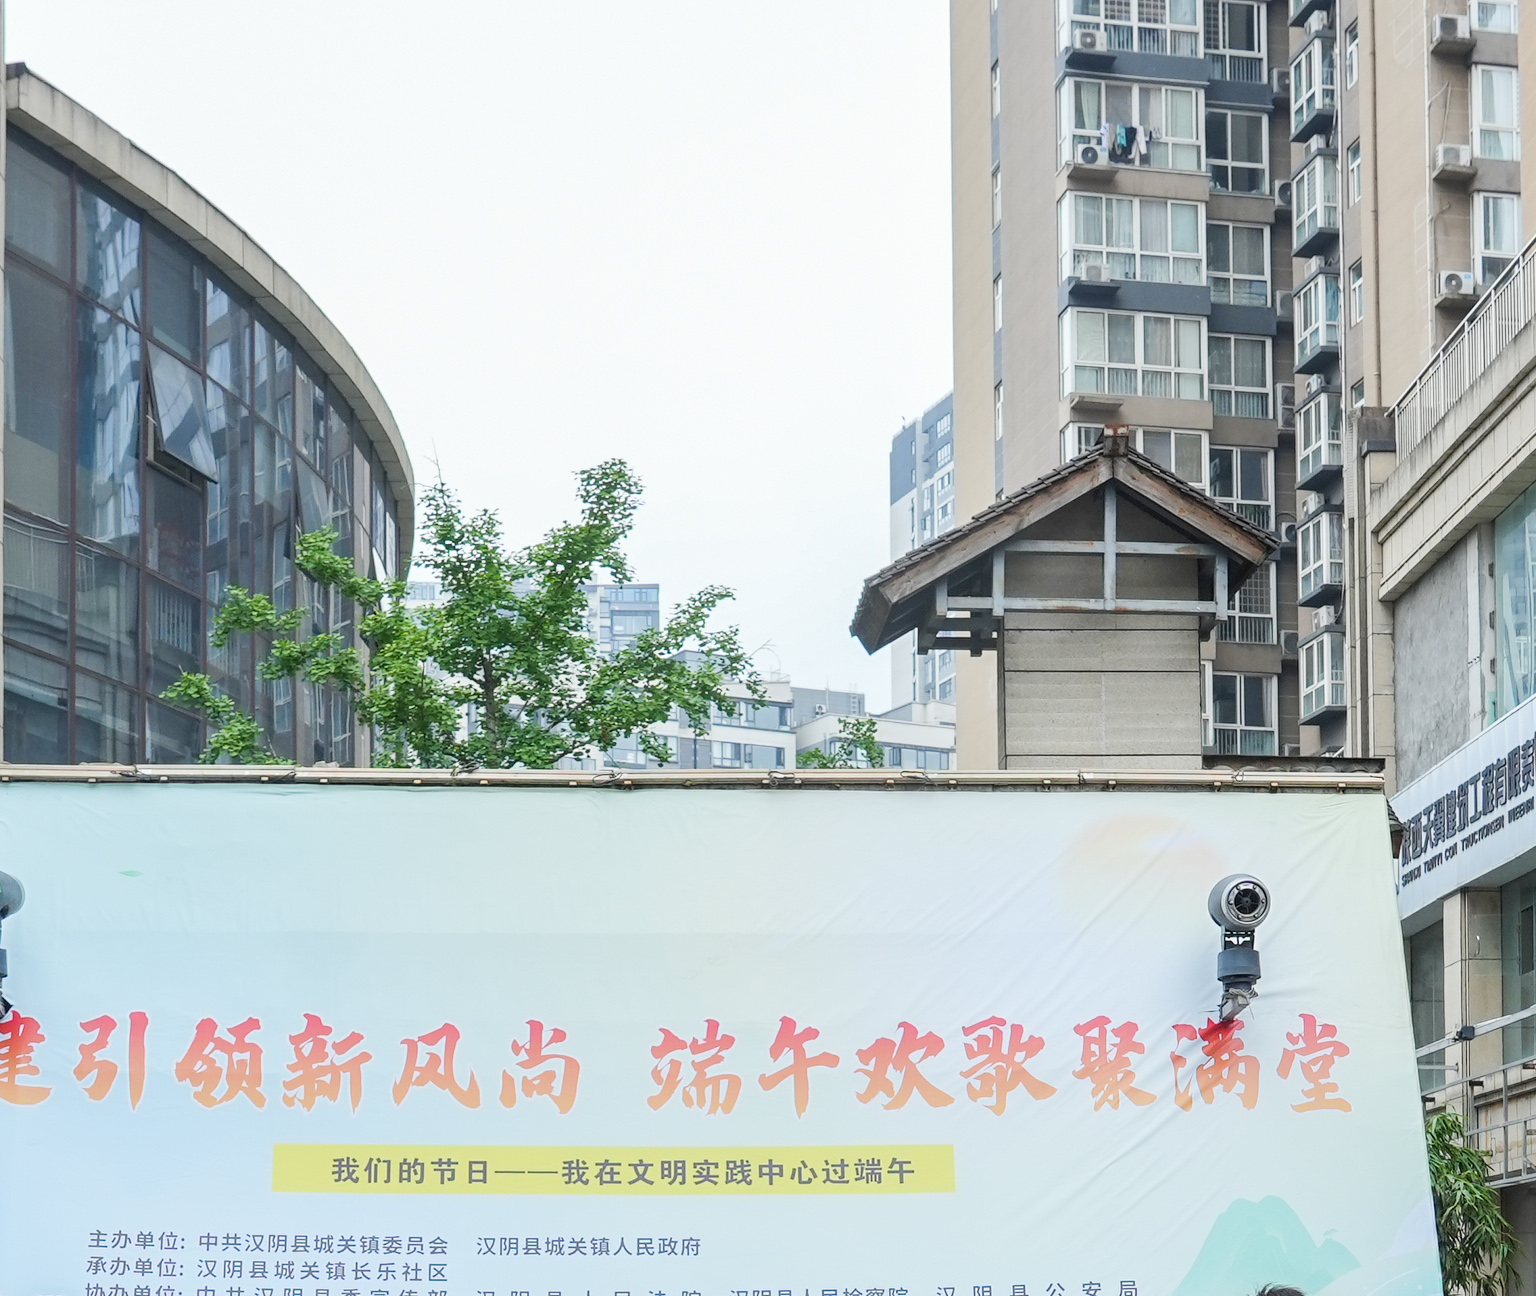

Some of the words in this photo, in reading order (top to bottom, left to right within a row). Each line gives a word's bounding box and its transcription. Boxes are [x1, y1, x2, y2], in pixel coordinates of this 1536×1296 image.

[646, 1012, 1353, 1120] 端午欢歌聚满堂
[331, 1155, 916, 1187] 我们的节日——我在文明实践中心过端午
[199, 1233, 449, 1256] 中共汉阴县城关镇委员会
[476, 1237, 701, 1256] 汉阴县城关镇人民政府
[197, 1258, 449, 1283] 汉阴县城关镇长乐社区
